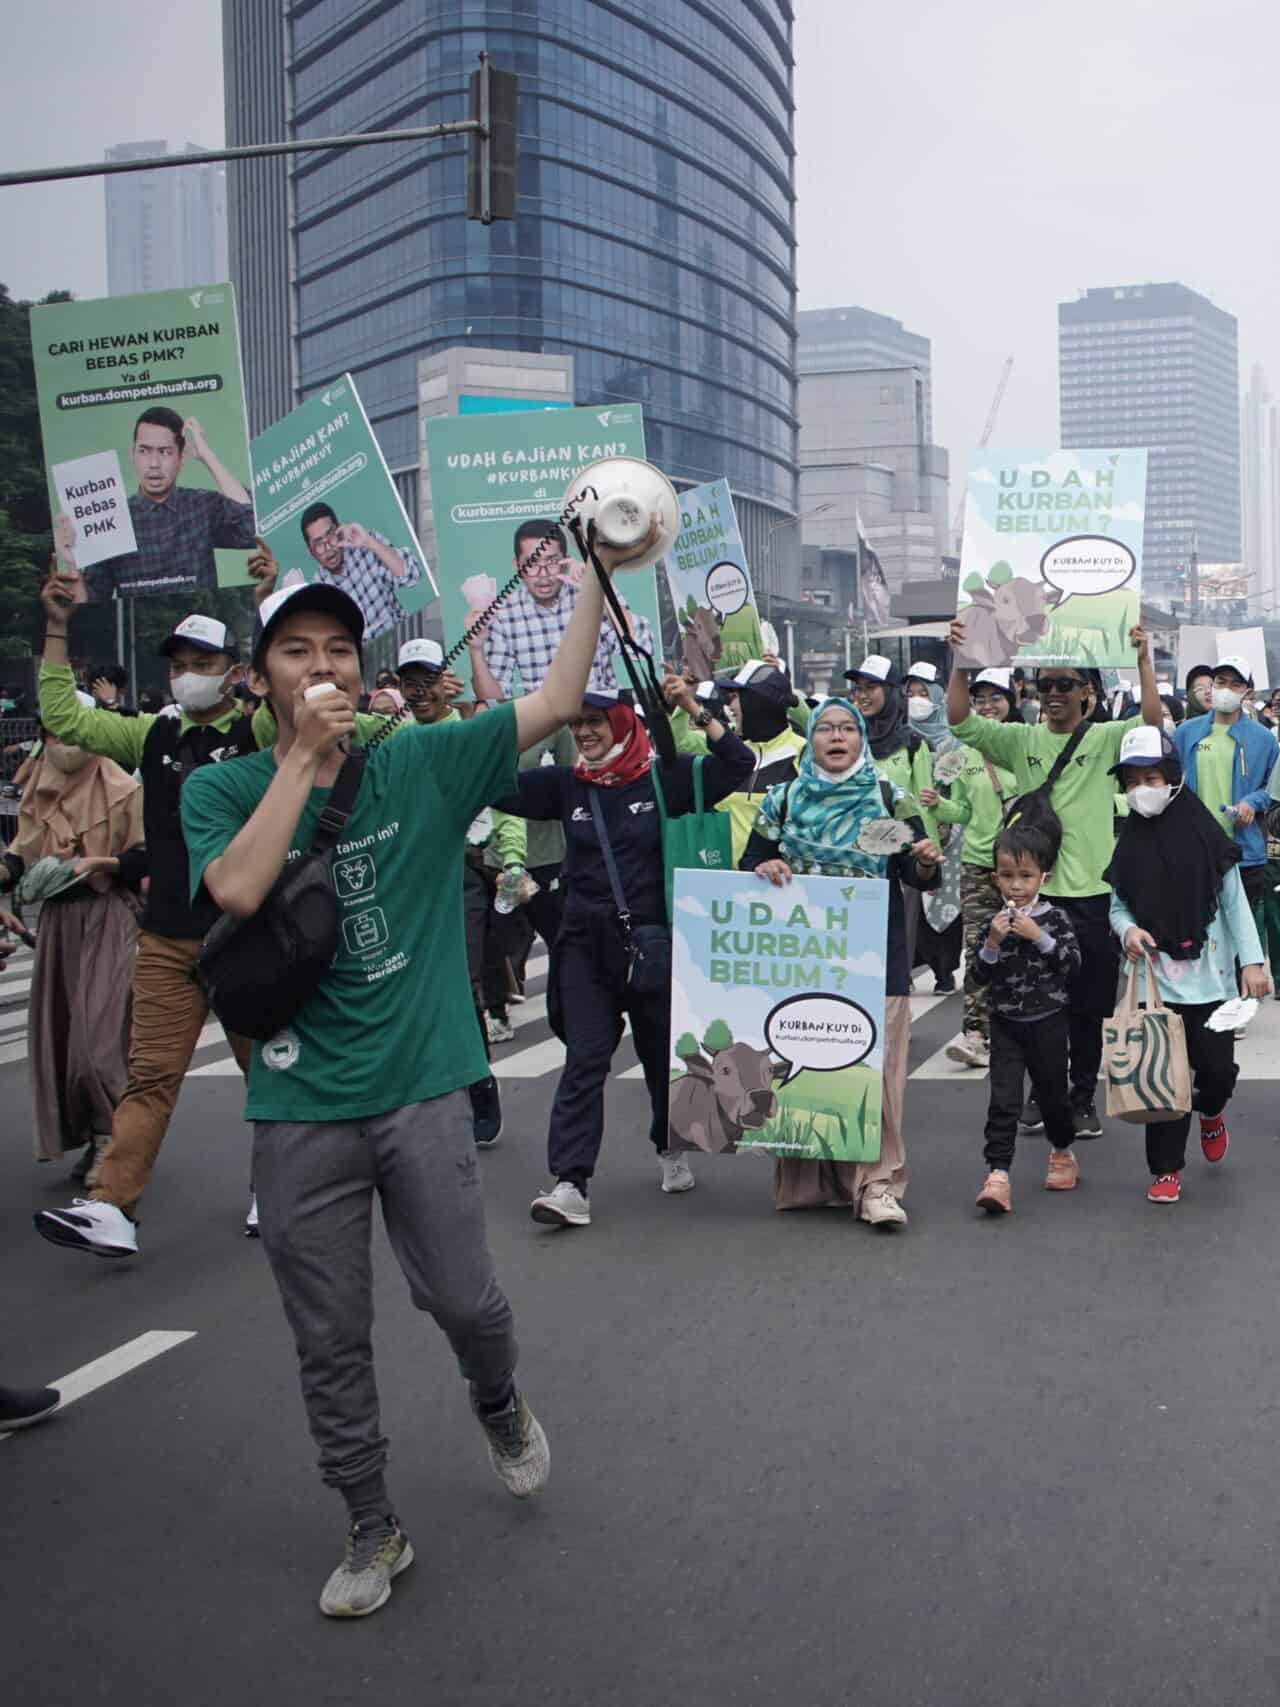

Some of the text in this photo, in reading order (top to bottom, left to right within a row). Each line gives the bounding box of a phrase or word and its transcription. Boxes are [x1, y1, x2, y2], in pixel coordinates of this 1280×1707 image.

[48, 322, 220, 356] CARI HEWAN KURBAN
[85, 347, 185, 371] BEBAS PMK?
[121, 370, 150, 383] Ya di
[61, 378, 217, 407] kurban.dompetdhuafa.org
[255, 467, 271, 486] AH
[317, 411, 350, 443] KAN?
[447, 451, 496, 468] UDAH
[578, 442, 627, 458] KAN?
[487, 466, 585, 485] #KURBANKU
[1000, 470, 1115, 489] UDAH
[65, 476, 116, 500] Kurban
[534, 488, 546, 498] di
[73, 497, 117, 519] Bebas
[458, 501, 561, 519] kurban.dompet
[996, 492, 1113, 511] KURBAN
[83, 517, 117, 538] PMK
[682, 502, 721, 529] DAH
[995, 514, 1090, 533] BELUM
[674, 523, 725, 552] KURBAN
[677, 550, 717, 571] BELUM
[336, 821, 400, 855] tahun ini?
[711, 900, 849, 930] UDAH
[710, 929, 848, 960] KURBAN
[709, 959, 821, 989] BELUM
[779, 1020, 824, 1032] KURBAN
[826, 1023, 849, 1033] KUY
